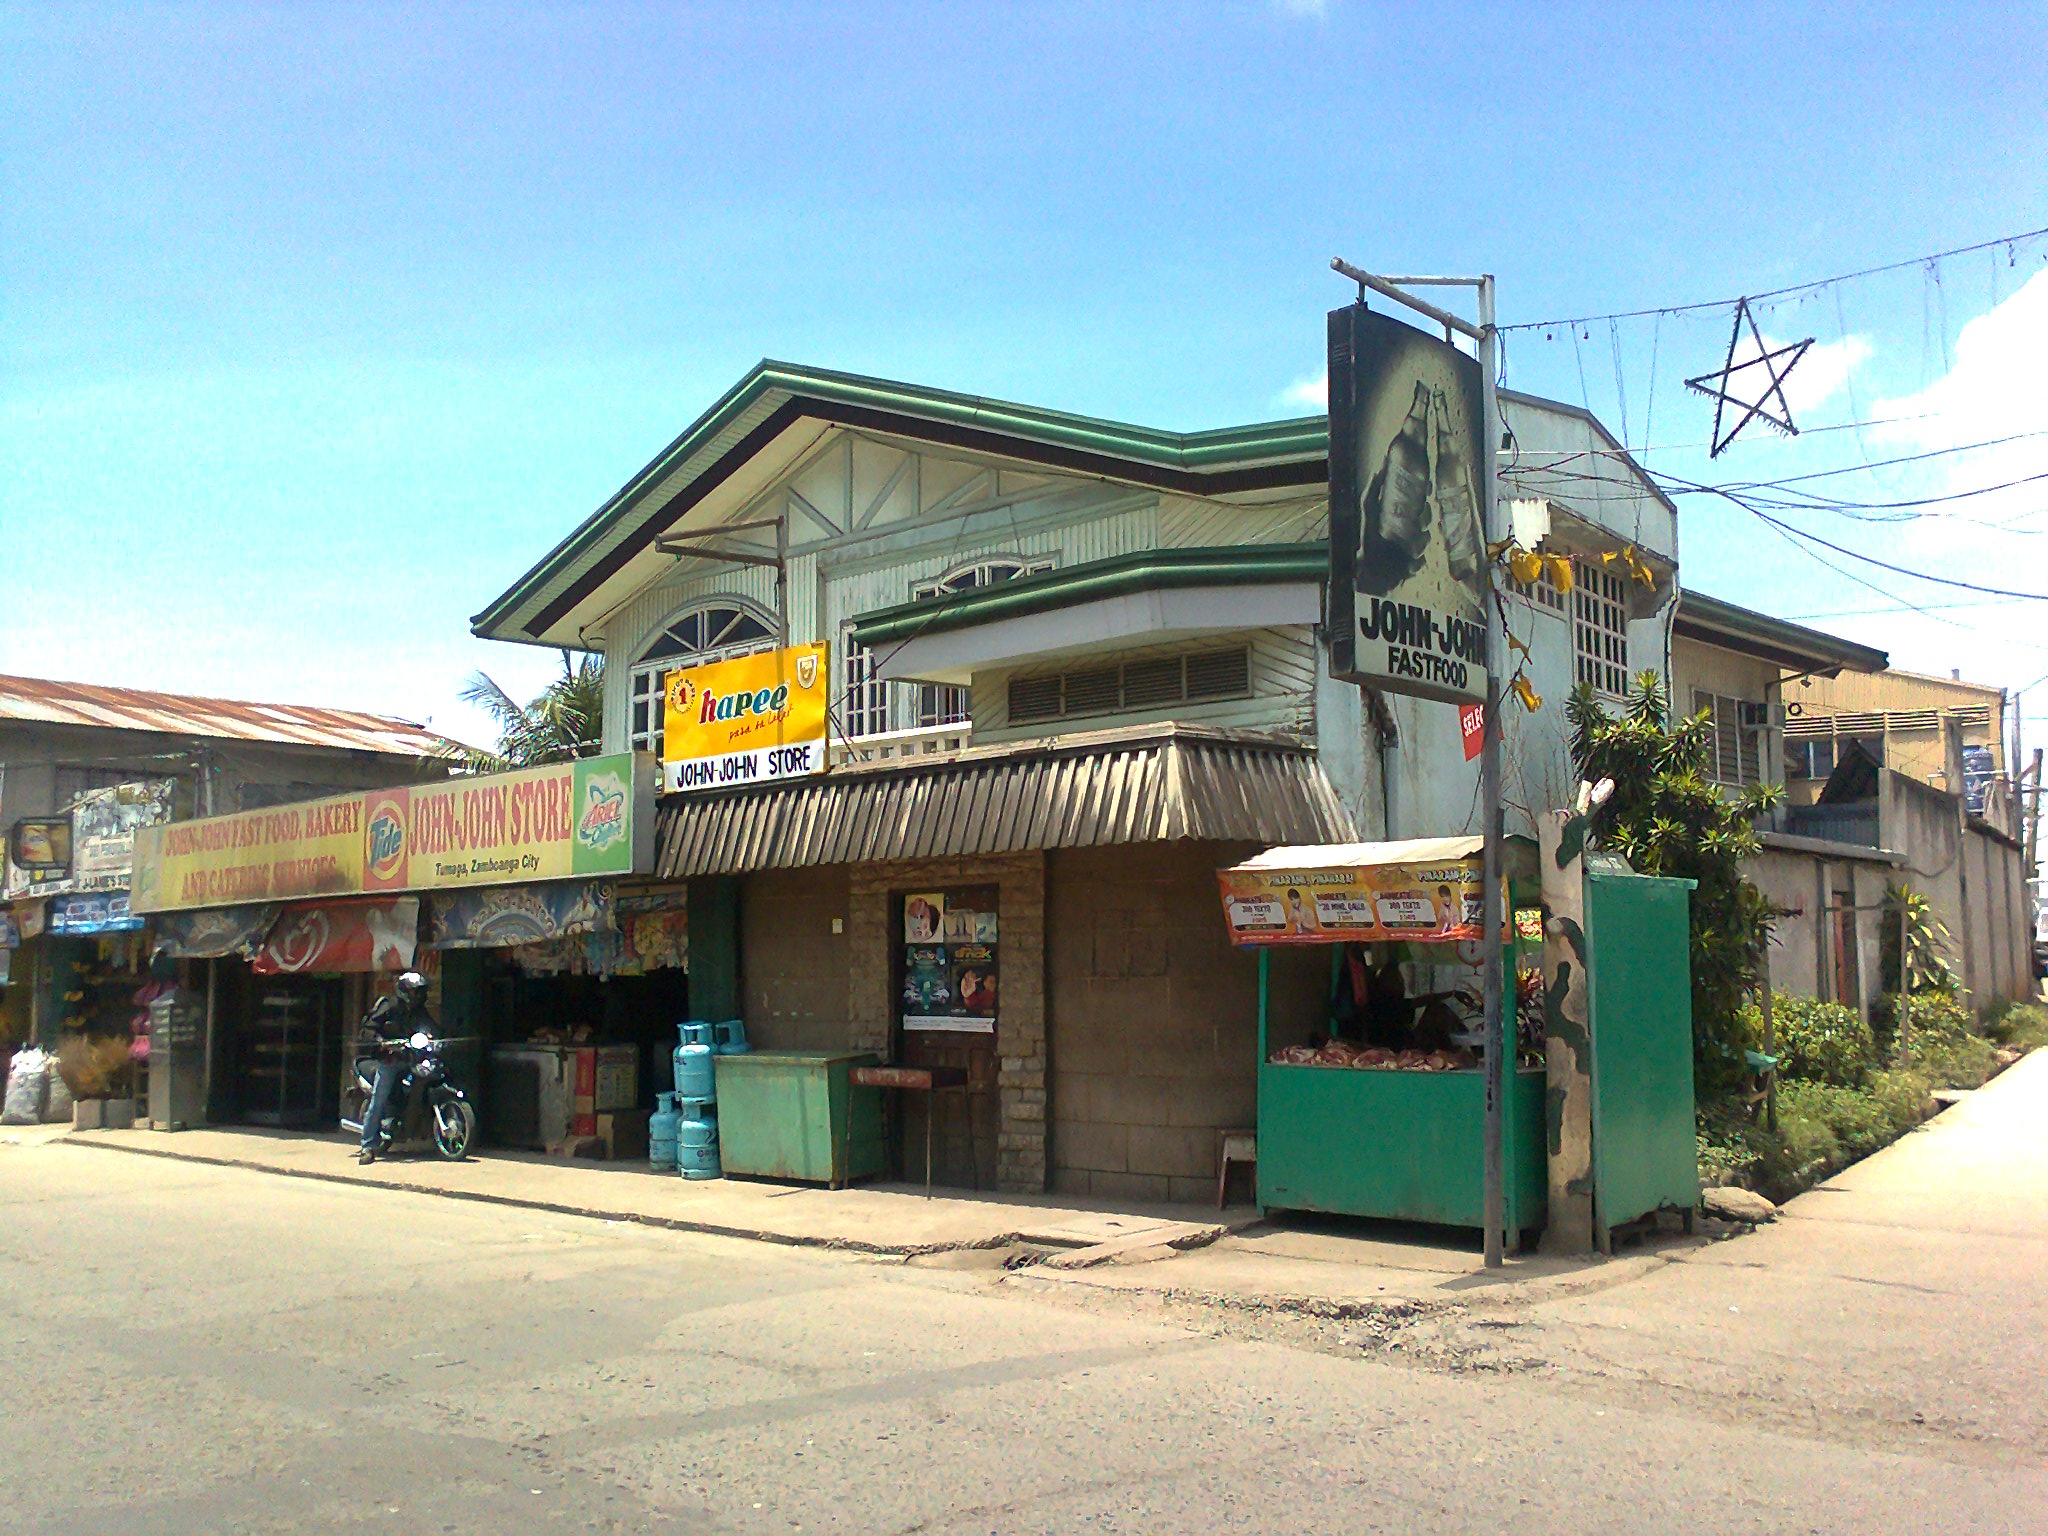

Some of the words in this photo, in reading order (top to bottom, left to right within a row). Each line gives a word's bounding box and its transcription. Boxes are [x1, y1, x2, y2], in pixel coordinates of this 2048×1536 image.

[1360, 598, 1488, 667] JOHN-JOHN
[1388, 646, 1468, 689] FASTFOOD
[699, 685, 788, 725] hapee
[677, 755, 758, 788] JOHN-JOHN
[769, 746, 811, 775] STORE
[231, 815, 263, 848] FAST
[305, 801, 362, 839] BAKERY
[408, 784, 508, 857] JOHN-JOHN
[510, 775, 572, 846] STORE
[582, 800, 621, 830] ARIEL
[369, 816, 402, 870] Tide
[471, 857, 519, 873] Zamboanga
[522, 854, 539, 872] City
[182, 869, 207, 900] AND
